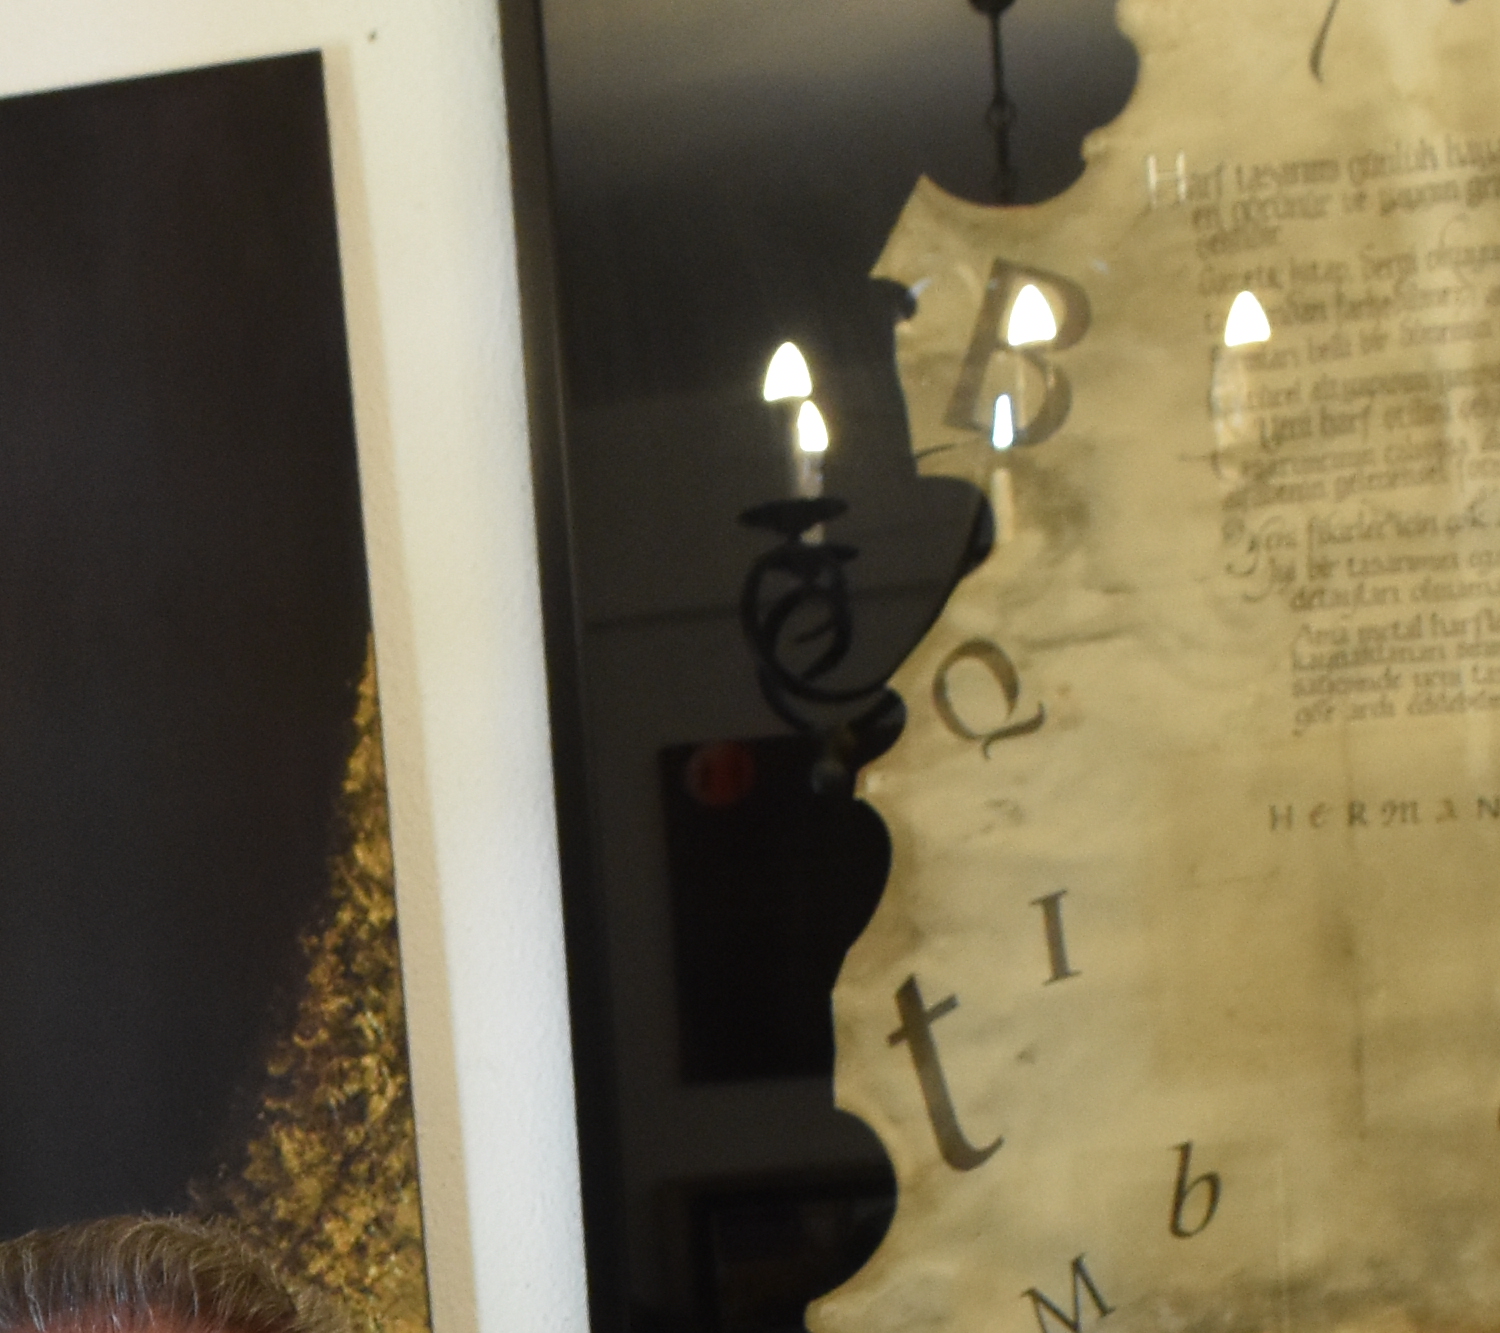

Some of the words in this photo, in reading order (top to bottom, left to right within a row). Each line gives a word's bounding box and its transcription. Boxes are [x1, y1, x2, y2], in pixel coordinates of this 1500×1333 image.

[944, 258, 1095, 447] B
[930, 637, 1046, 760] Q
[886, 972, 1003, 1174] t
[1168, 1142, 1223, 1241] b
